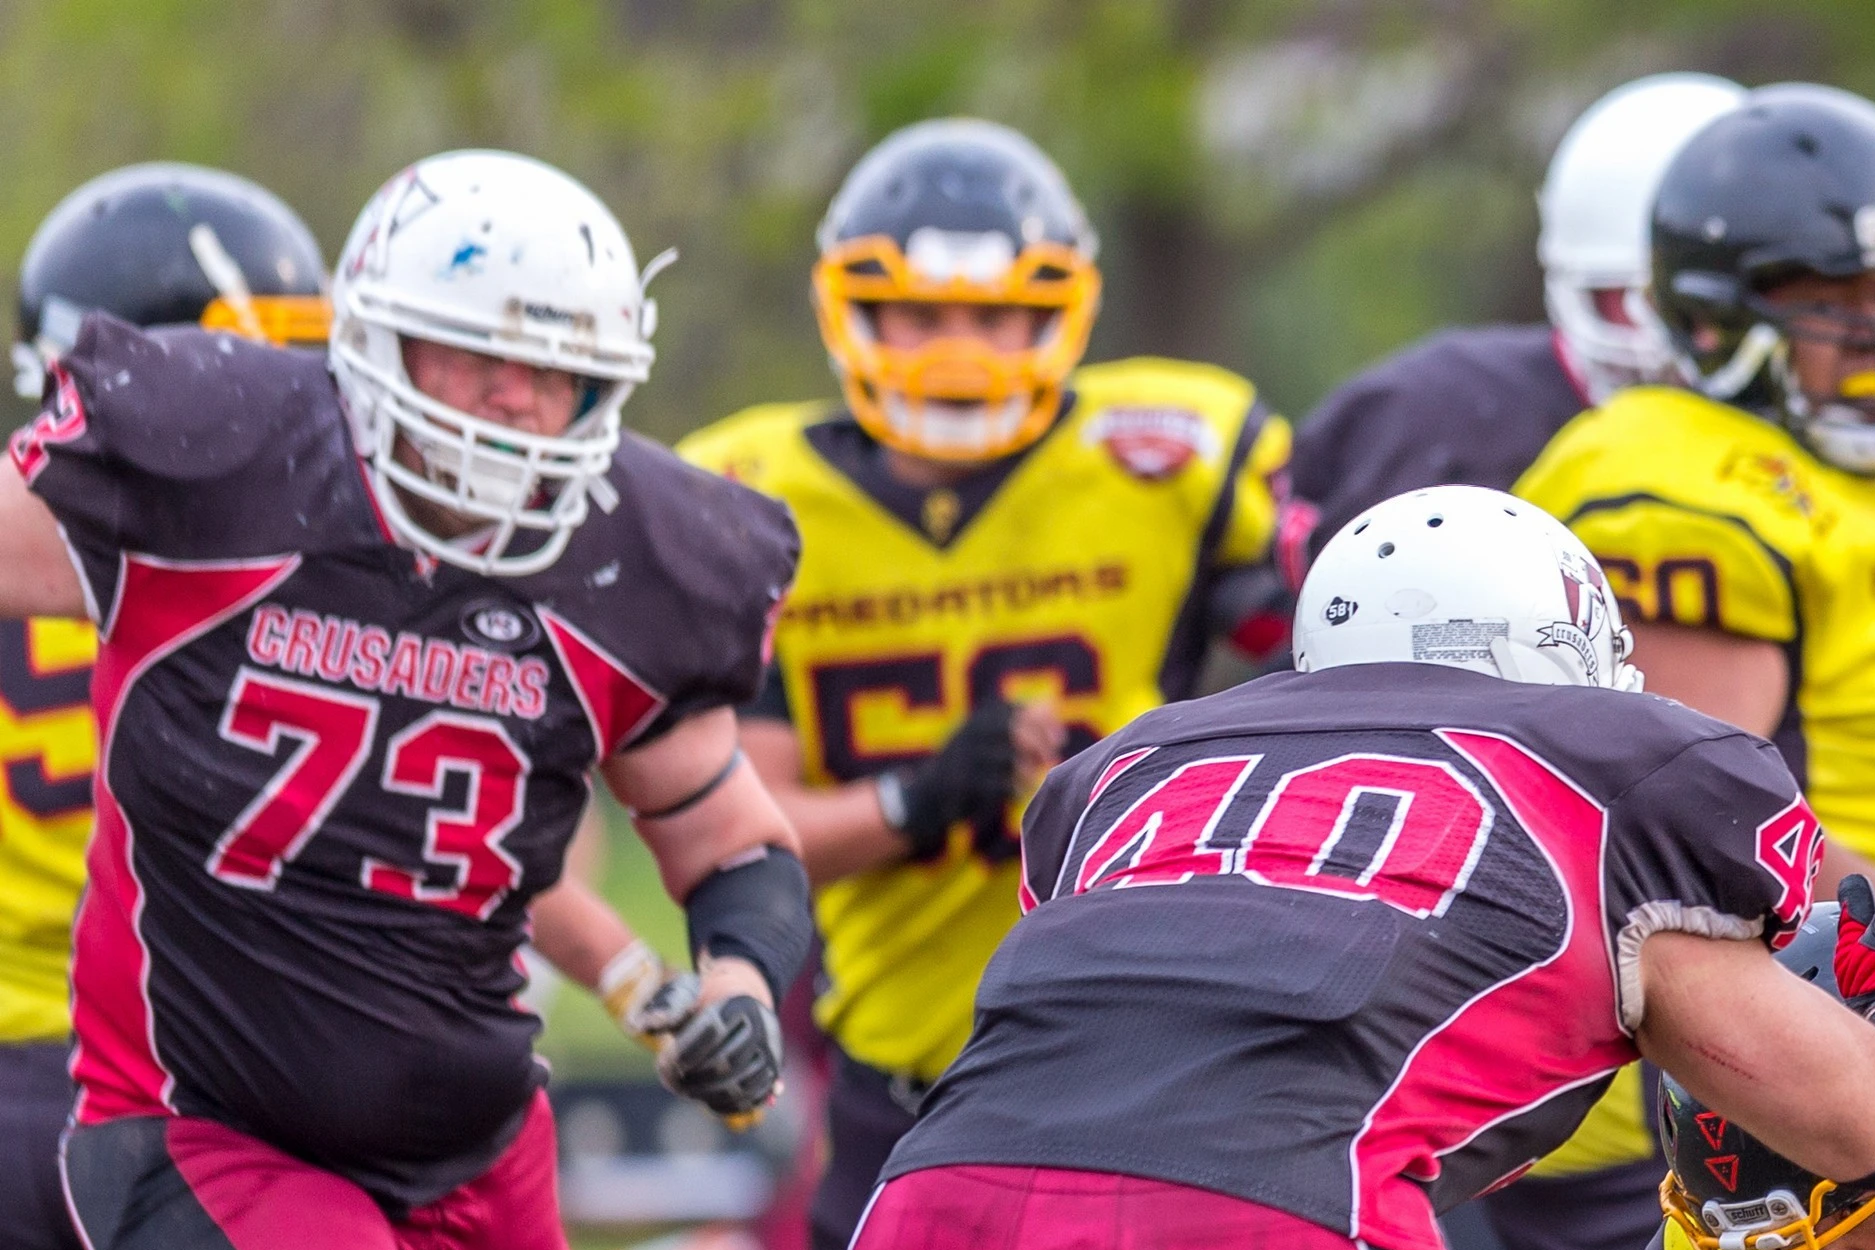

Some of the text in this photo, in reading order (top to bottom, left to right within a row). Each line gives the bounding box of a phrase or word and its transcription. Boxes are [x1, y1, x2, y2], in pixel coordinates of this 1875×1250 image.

[247, 604, 549, 720] CRUSADERS
[1329, 603, 1347, 619] 58
[204, 664, 534, 922] 73
[1074, 752, 1496, 920] 40
[1731, 1206, 1765, 1220] schutt
